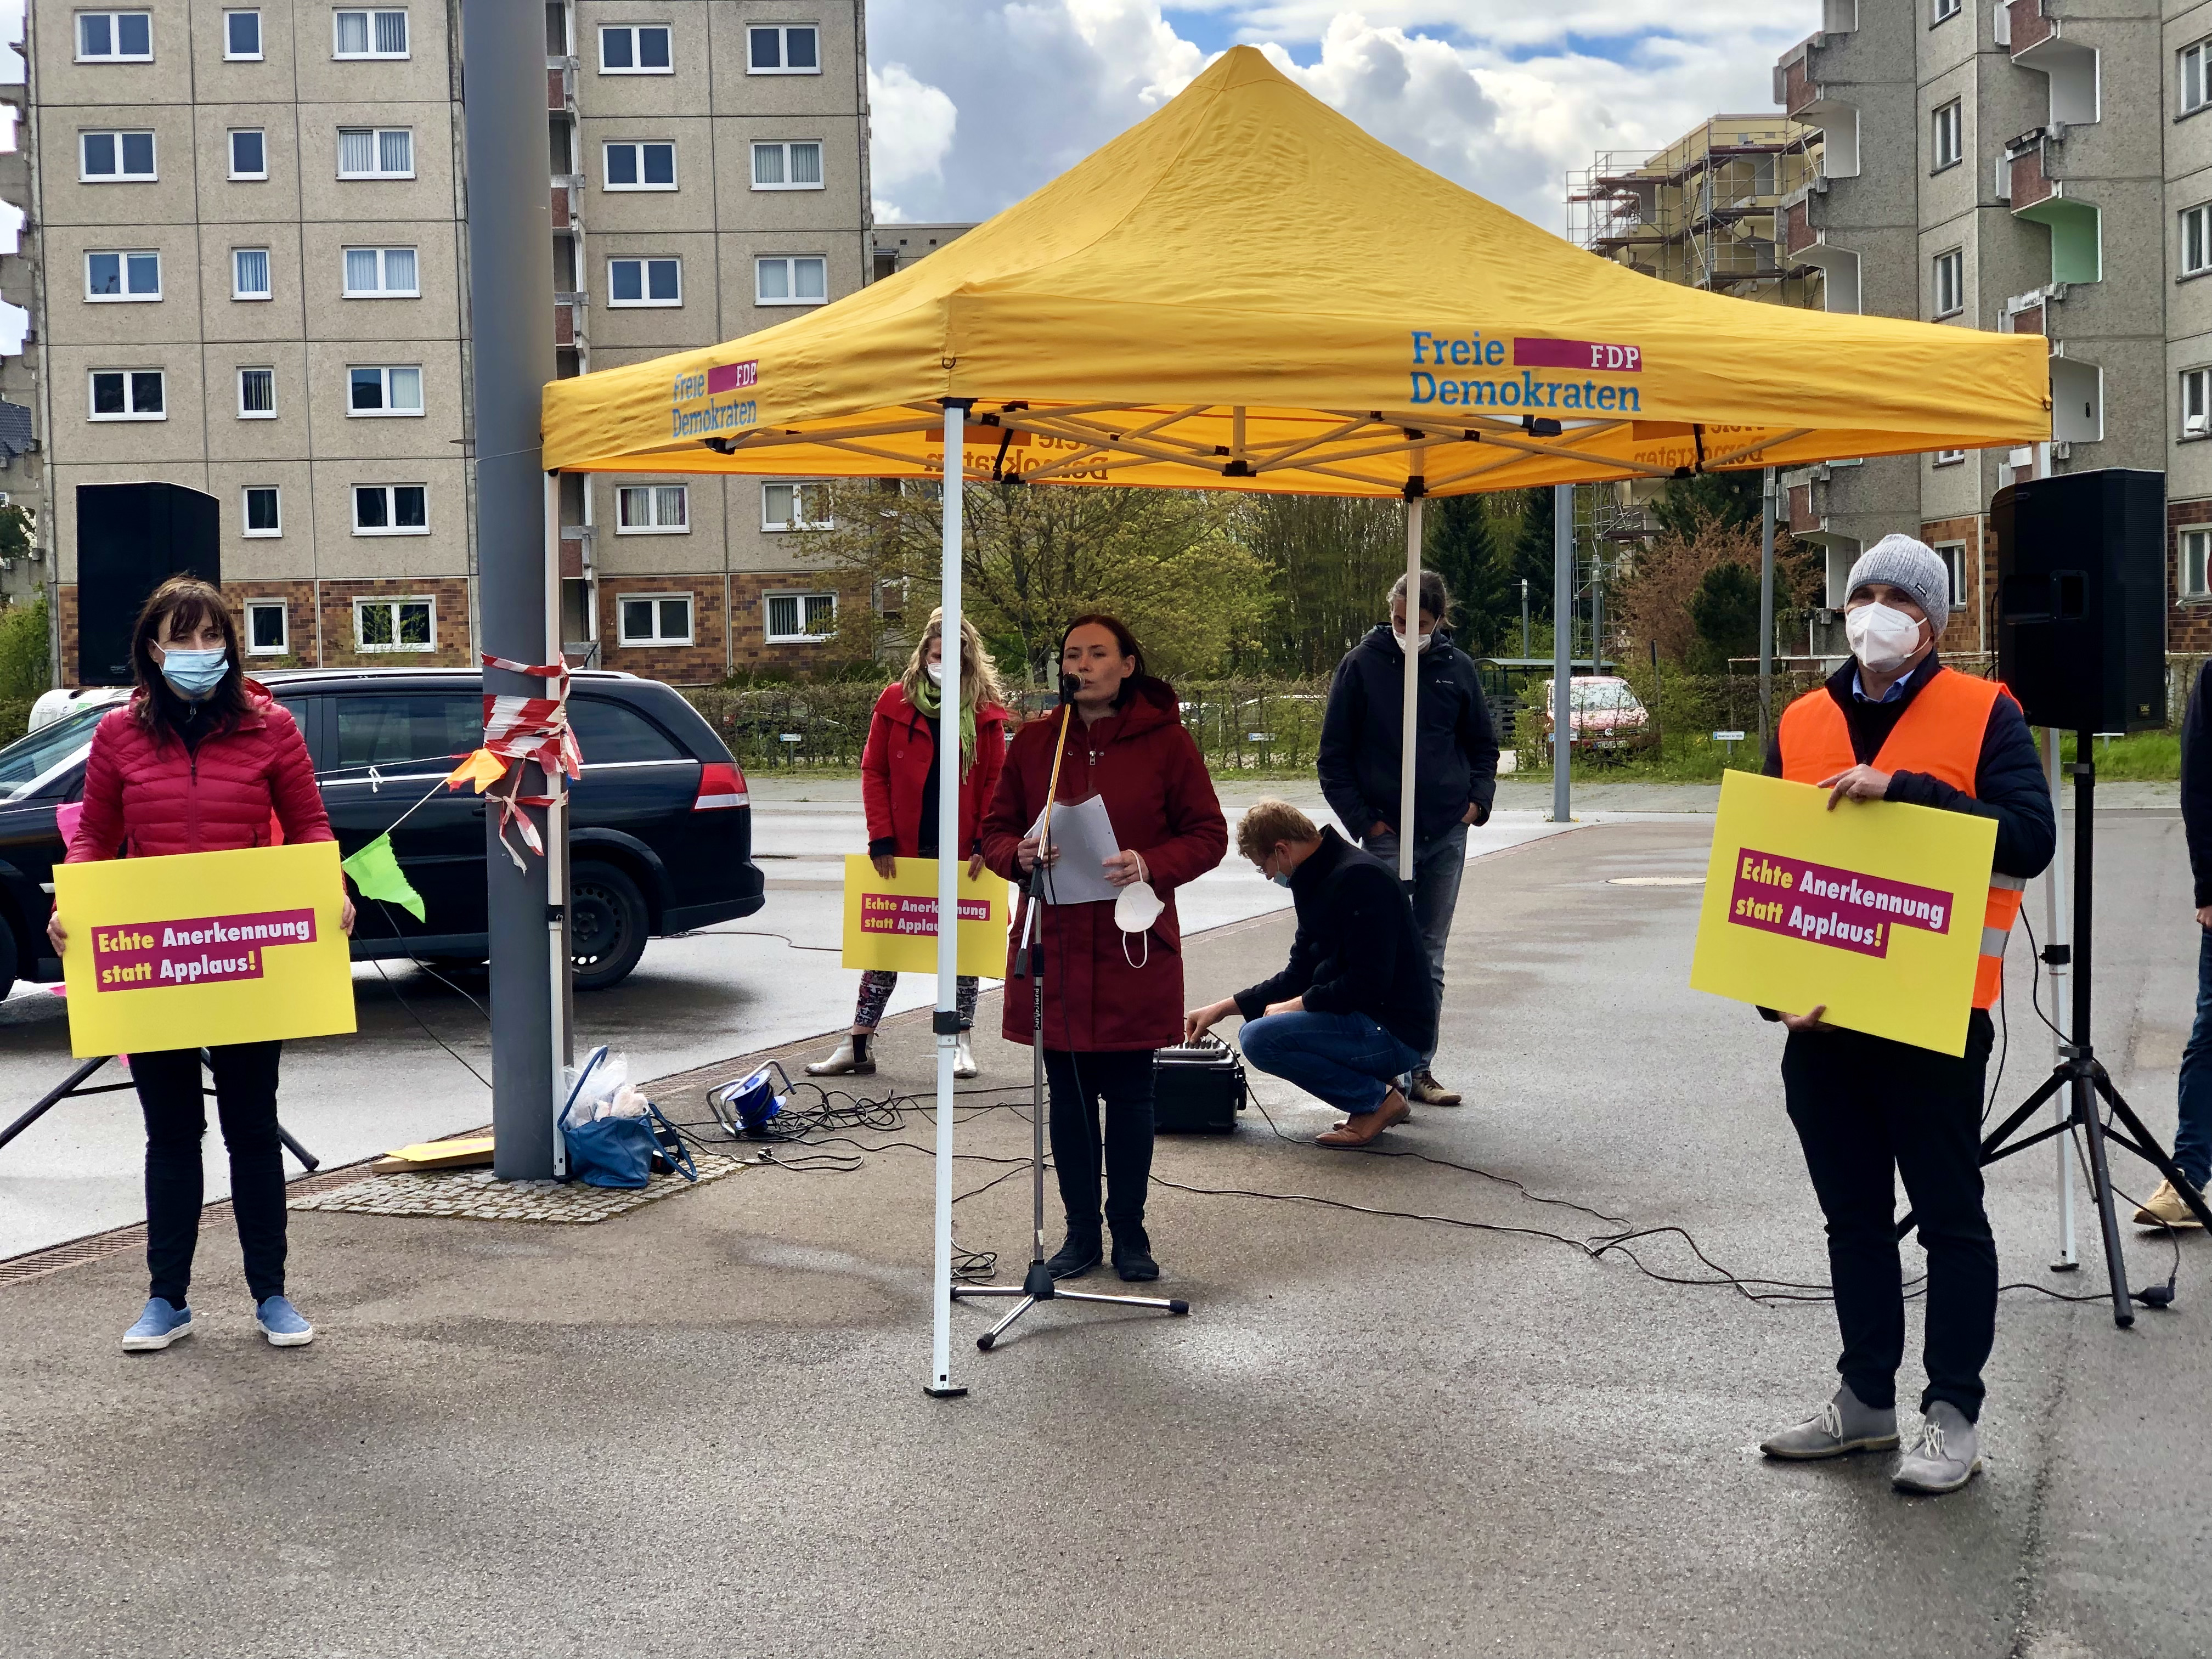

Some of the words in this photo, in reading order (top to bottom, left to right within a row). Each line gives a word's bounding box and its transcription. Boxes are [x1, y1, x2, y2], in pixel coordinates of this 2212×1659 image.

[1410, 331, 1505, 365] Freie
[1590, 345, 1640, 370] FDP
[673, 368, 704, 402] Freie
[736, 363, 757, 387] FDP
[1409, 370, 1641, 412] Demokraten
[673, 398, 757, 437] Demokraten
[865, 898, 898, 911] Echte
[901, 900, 986, 919] Anerknung
[1741, 857, 1794, 890] Echte
[1799, 870, 1945, 930] Anerkennung
[97, 930, 155, 953] Echte
[162, 919, 310, 947] Anerkennung
[864, 917, 894, 929] statt
[1735, 896, 1784, 924] statt
[1787, 905, 1884, 947] Applaus!
[101, 962, 152, 984] statt
[159, 950, 257, 983] Applaus!
